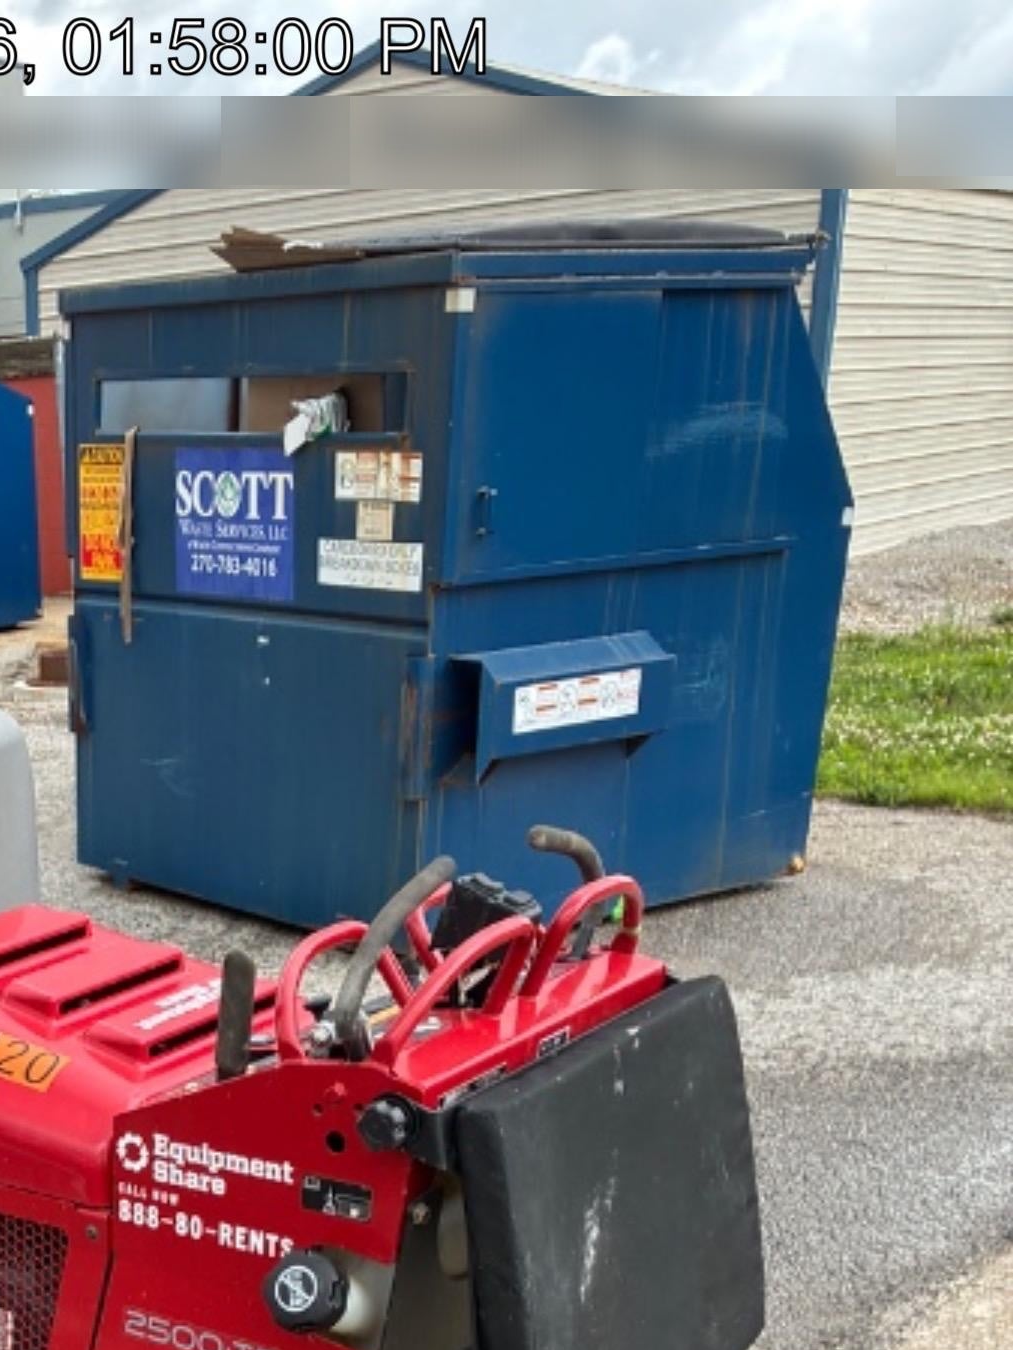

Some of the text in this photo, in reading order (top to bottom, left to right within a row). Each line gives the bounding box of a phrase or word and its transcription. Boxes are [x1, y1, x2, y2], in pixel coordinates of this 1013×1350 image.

[175, 469, 294, 520] SCOTT
[268, 524, 288, 541] LLC
[152, 1133, 295, 1184] Equipment
[152, 1160, 226, 1195] Share
[118, 1181, 179, 1206] CALL NOW
[118, 1199, 295, 1258] 888-80-RENTS
